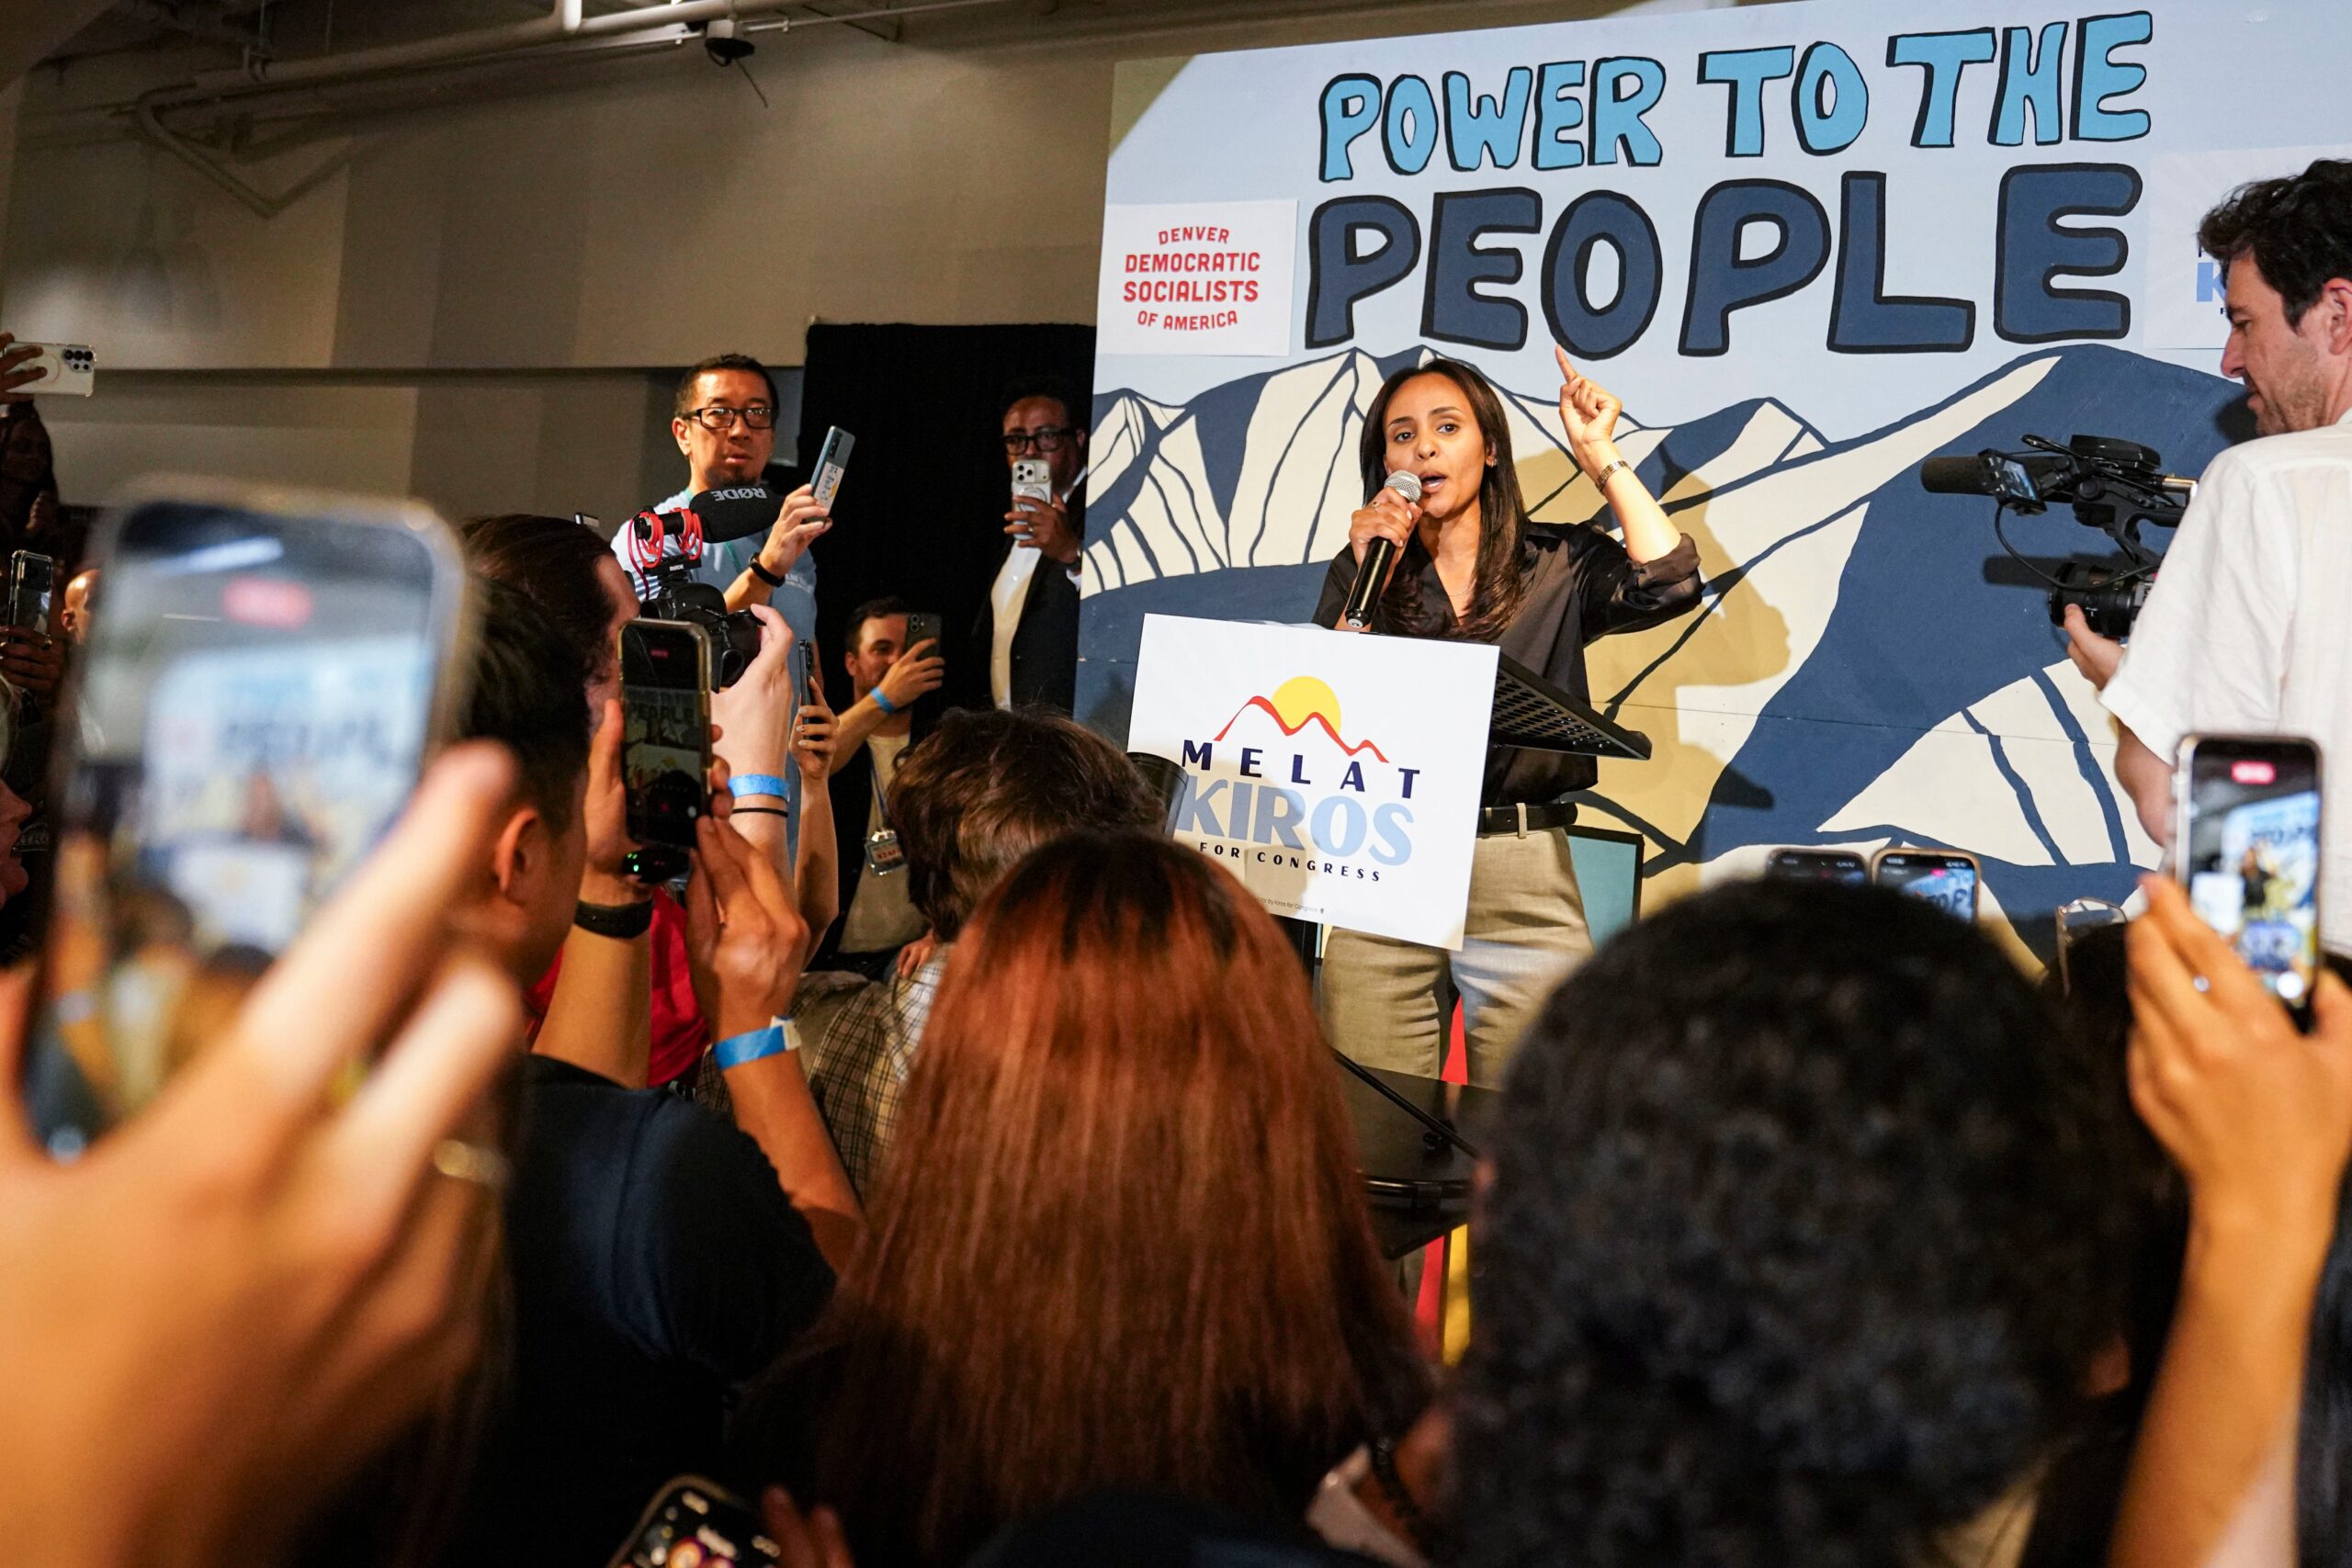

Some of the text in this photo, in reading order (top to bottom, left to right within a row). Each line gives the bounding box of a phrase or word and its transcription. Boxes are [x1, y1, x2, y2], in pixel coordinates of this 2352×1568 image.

[1318, 10, 2154, 183] POWER TO THE
[1159, 226, 1230, 245] DENVER
[1125, 252, 1261, 273] DEMOCRATIC
[1305, 162, 2143, 361] PEOPLE
[1123, 280, 1260, 302] SOCIALISTS
[1137, 310, 1238, 331] OF AMERICA
[1182, 739, 1420, 799] MELAT
[1175, 775, 1415, 866] KIROS
[1199, 841, 1380, 882] FOR CONGRESS
